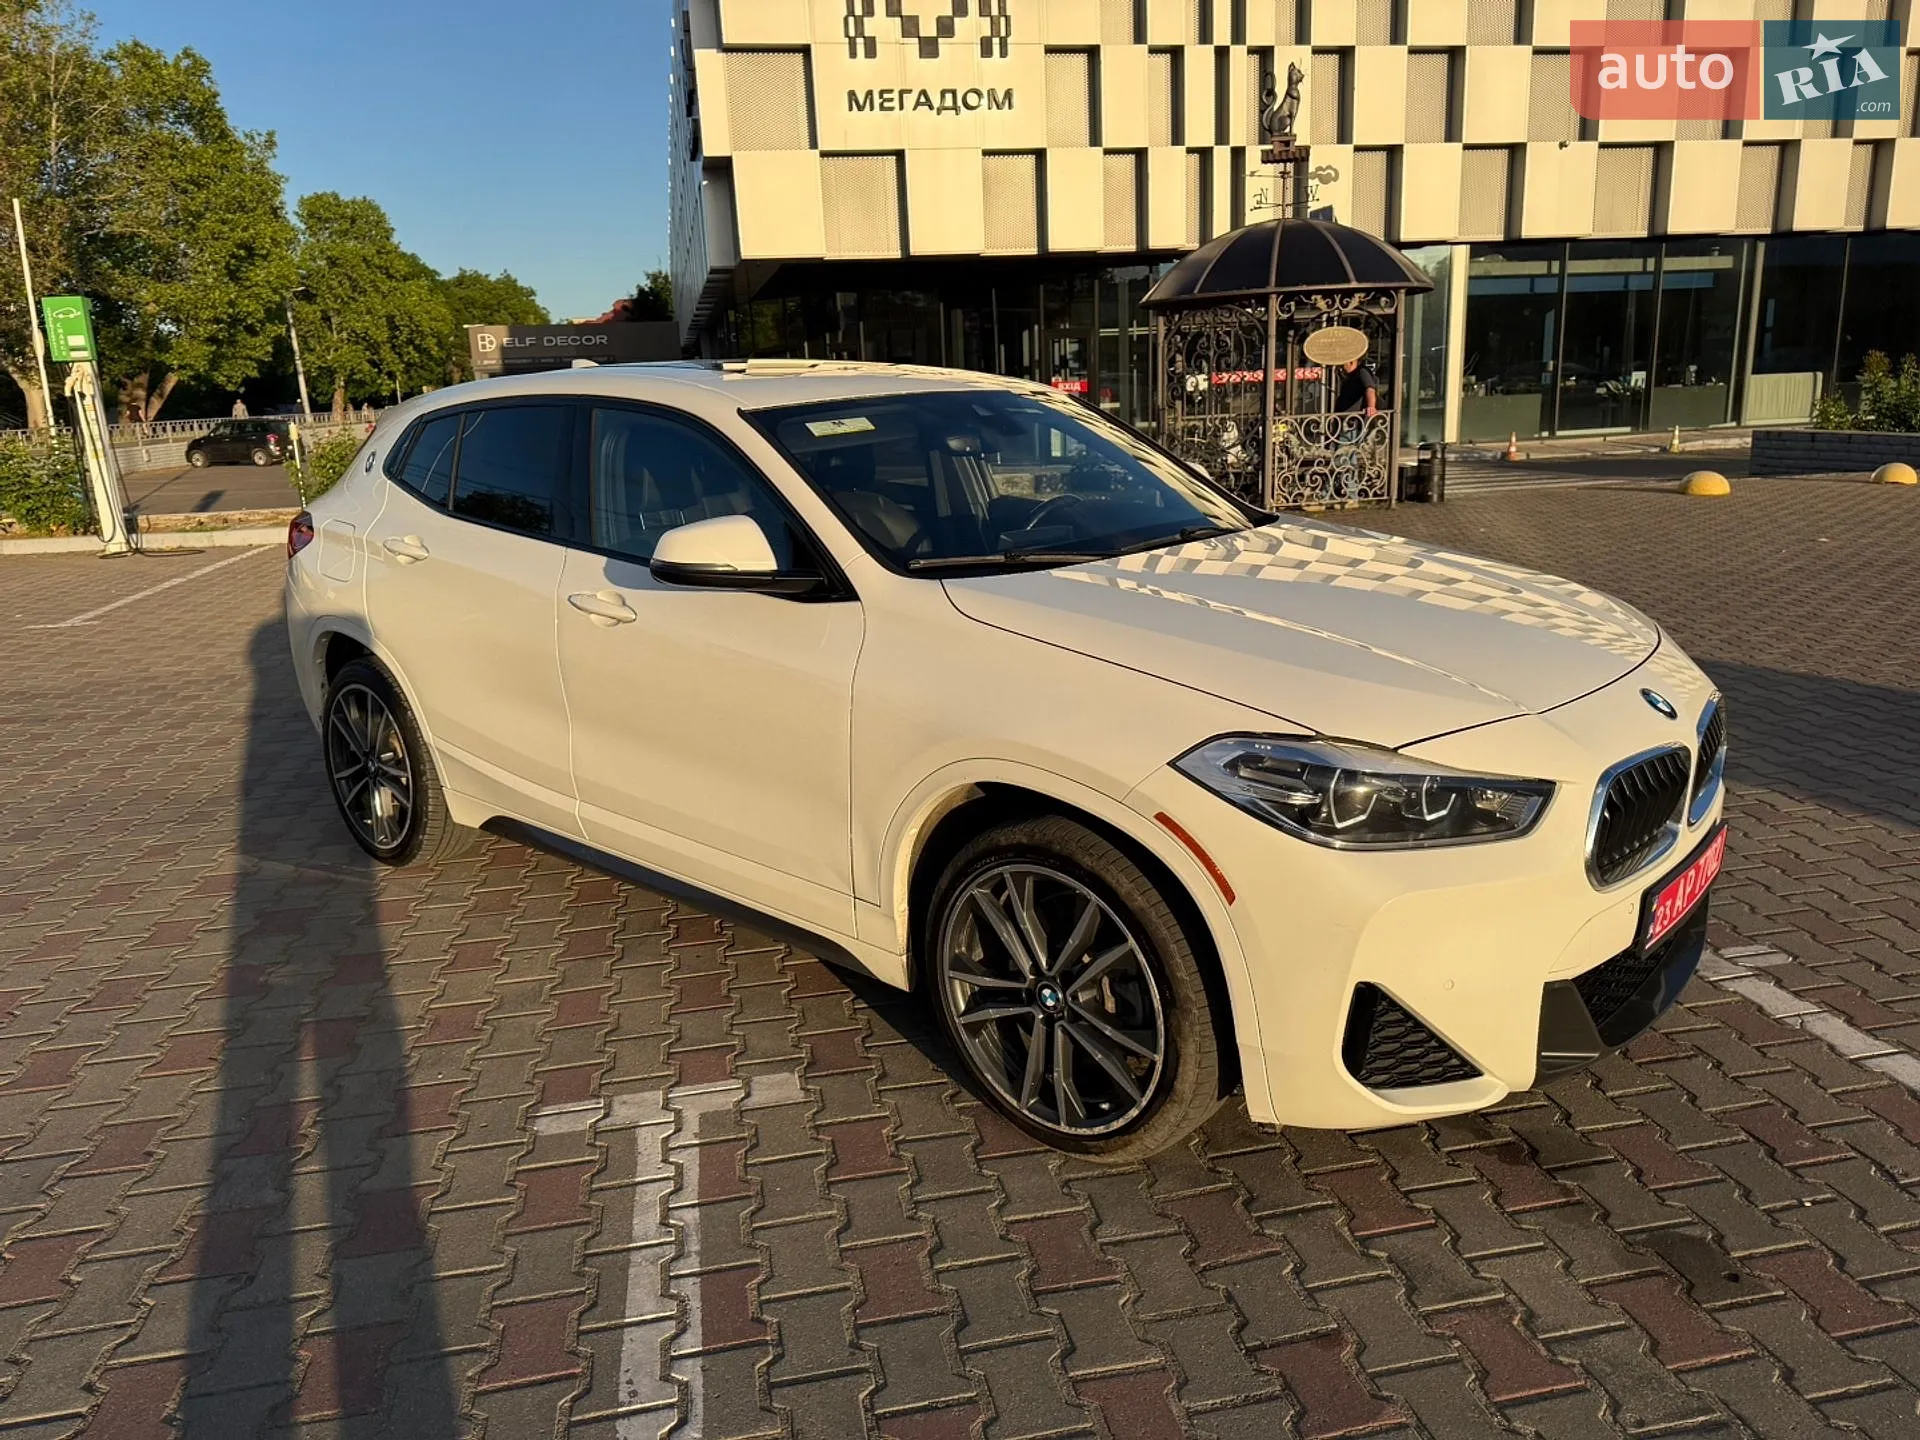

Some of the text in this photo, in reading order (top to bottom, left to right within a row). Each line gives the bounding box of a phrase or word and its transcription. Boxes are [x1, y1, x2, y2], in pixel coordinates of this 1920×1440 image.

[847, 88, 1014, 115] МЕГАДОМ
[503, 335, 608, 348] ELF DECOR
